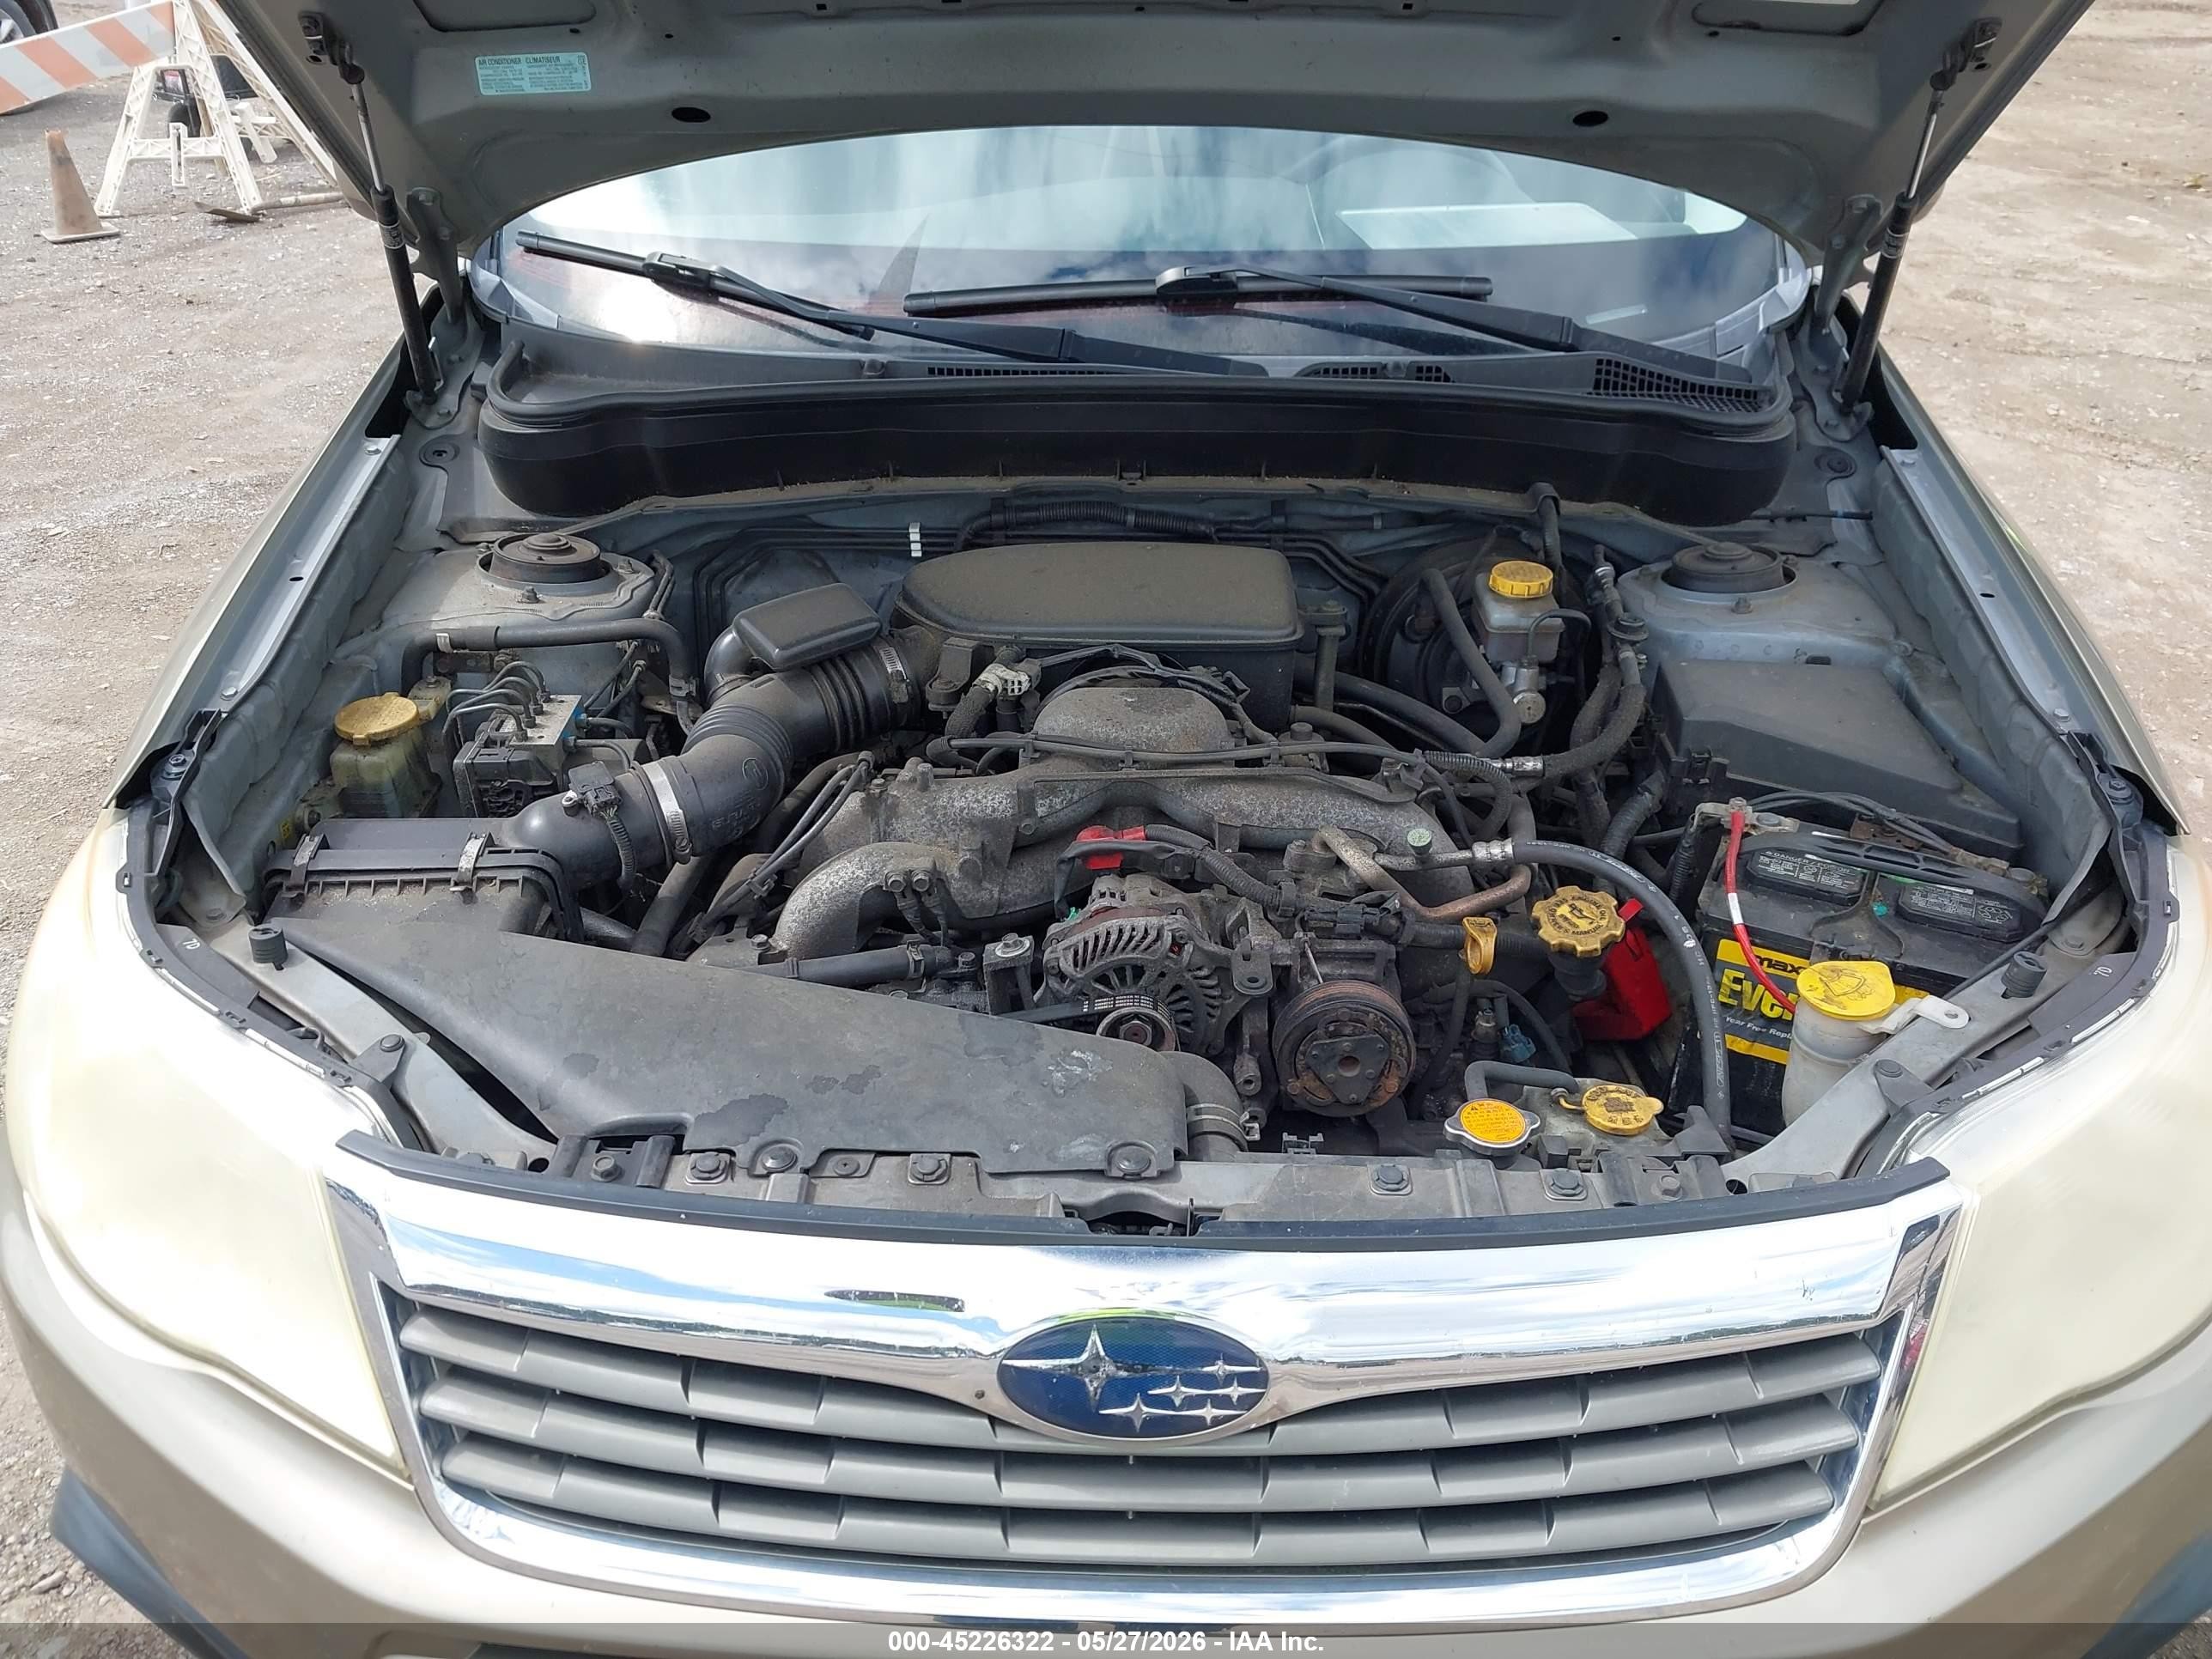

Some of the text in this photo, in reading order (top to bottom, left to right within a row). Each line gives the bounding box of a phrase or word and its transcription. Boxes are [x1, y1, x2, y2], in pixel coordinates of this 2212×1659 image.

[1773, 852, 1809, 863] DANGER
[1725, 1016, 1746, 1026] Year
[1747, 1022, 1767, 1032] Free
